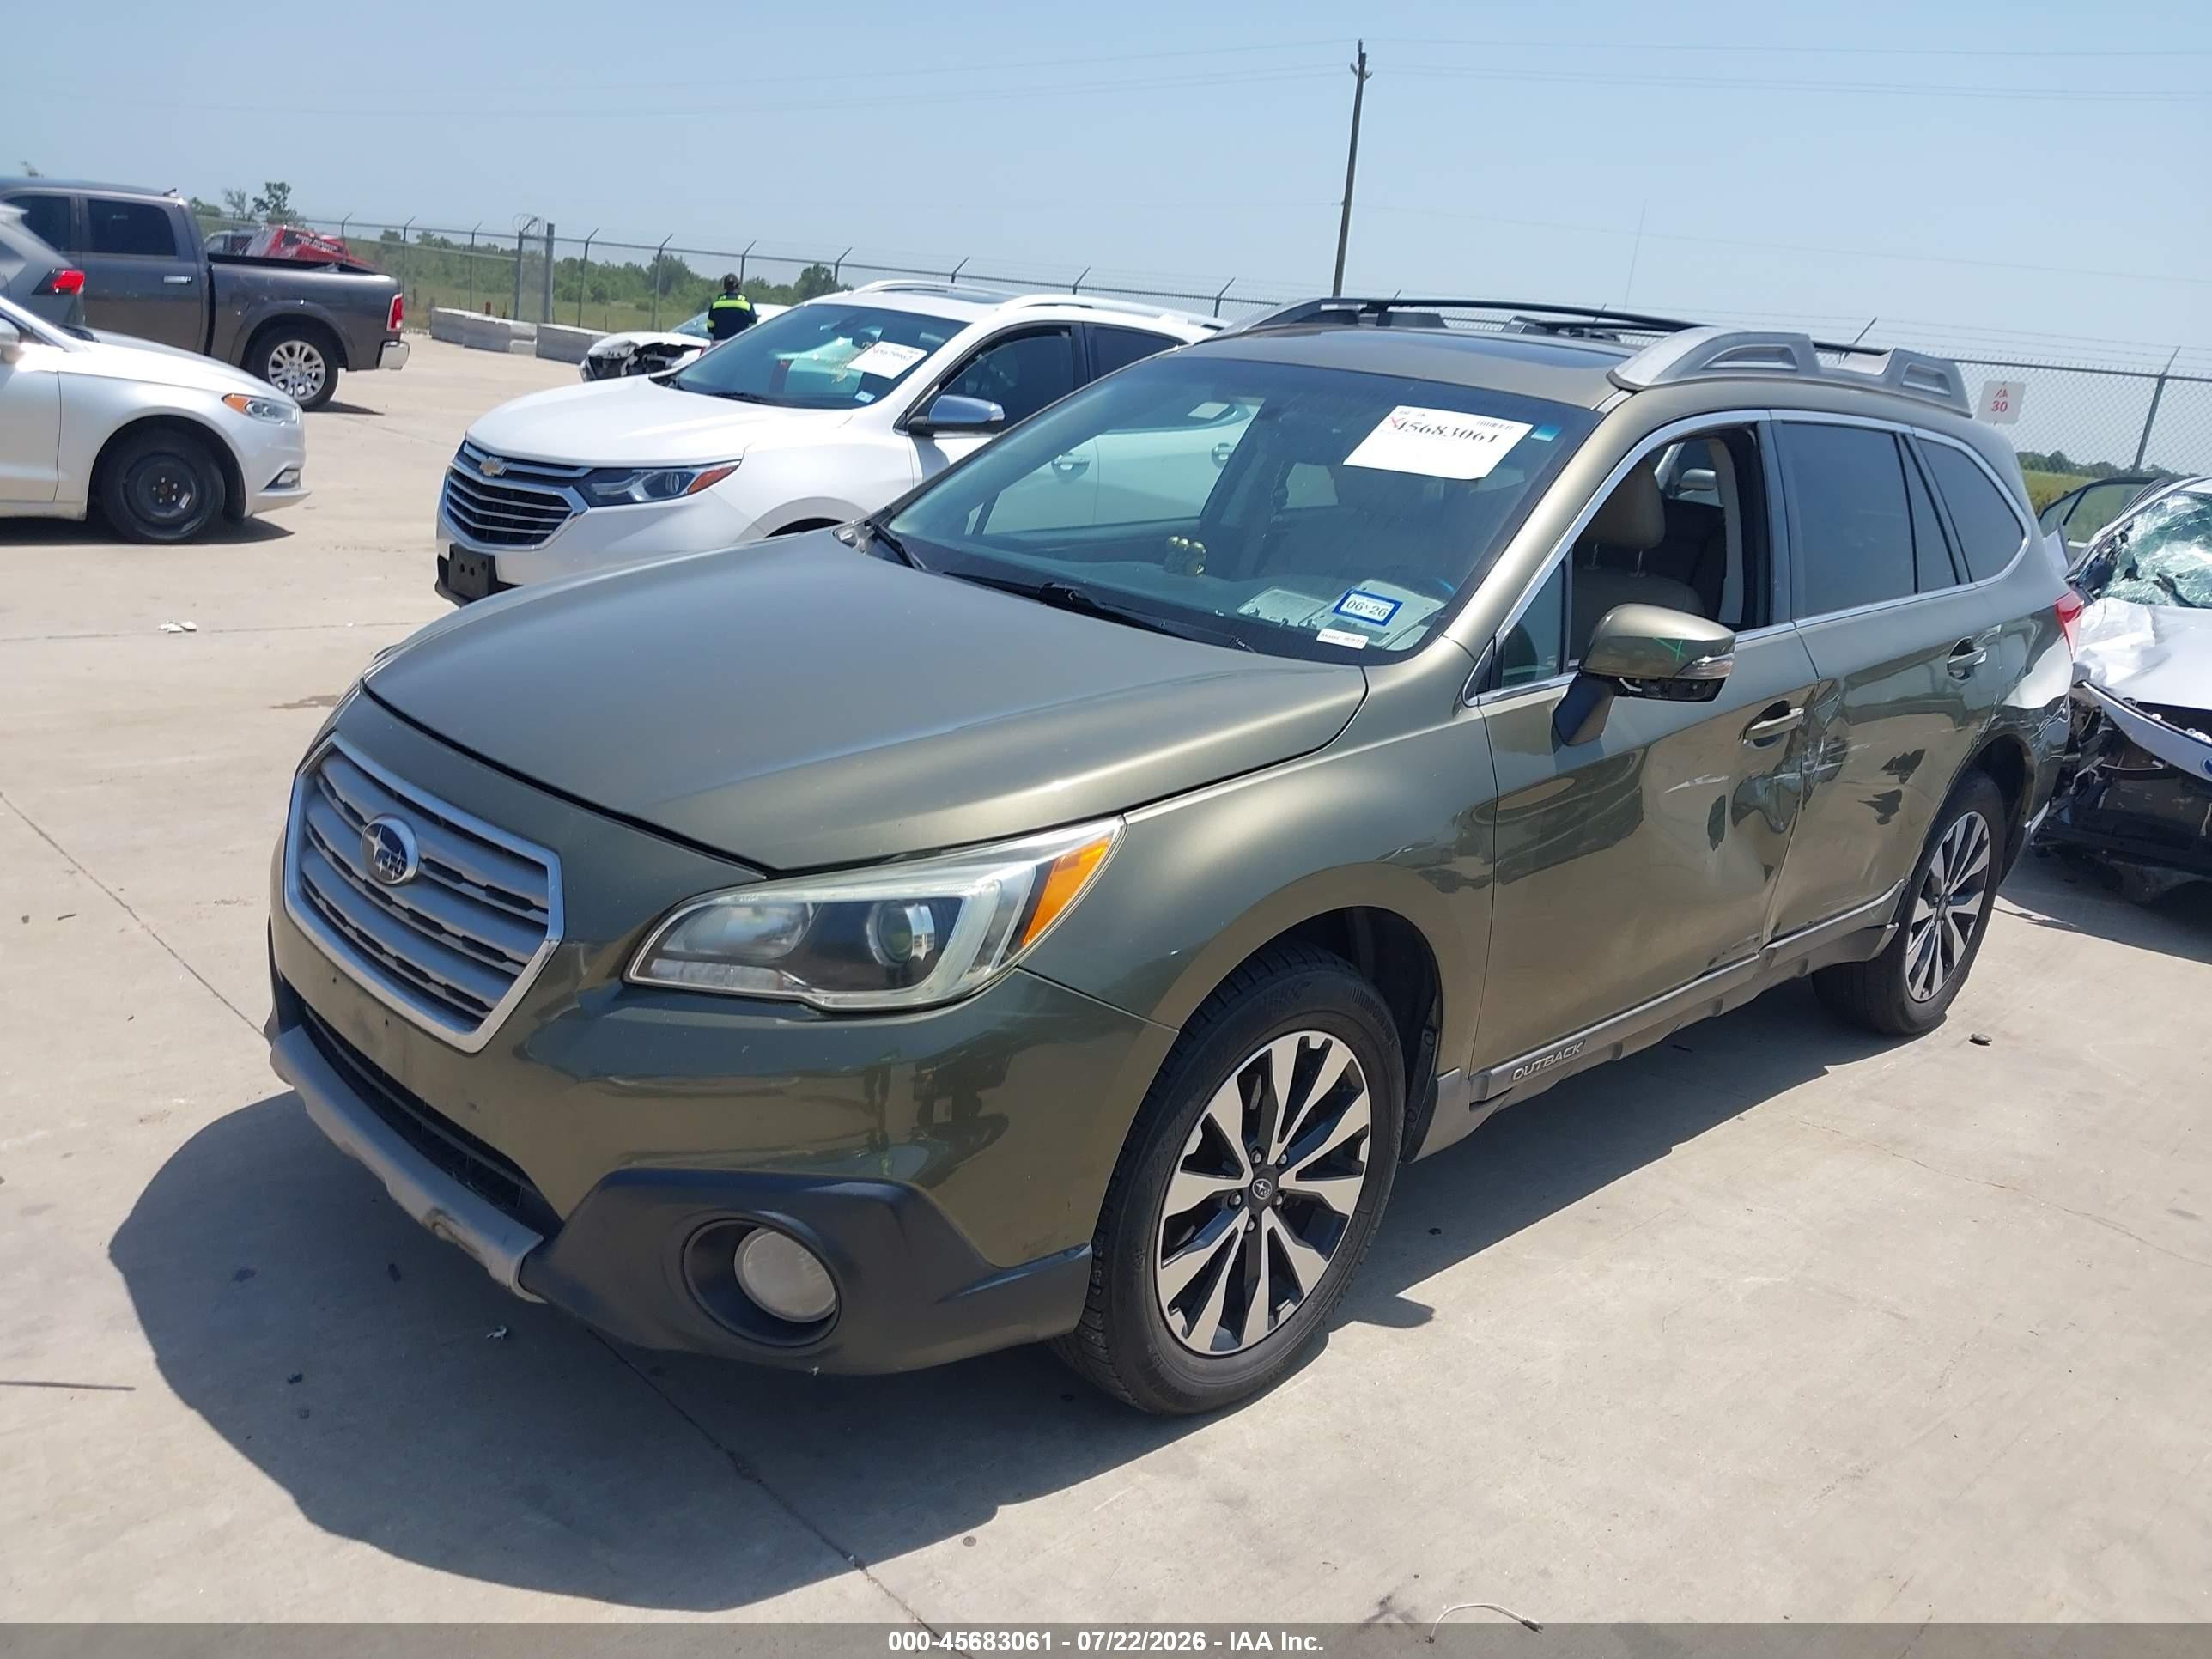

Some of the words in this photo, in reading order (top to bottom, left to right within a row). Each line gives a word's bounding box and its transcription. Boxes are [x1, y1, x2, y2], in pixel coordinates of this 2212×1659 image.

[1990, 400, 2008, 413] 30
[1346, 599, 1364, 611] 06
[1368, 605, 1389, 617] 26
[1512, 1042, 1583, 1080] OUTBACK
